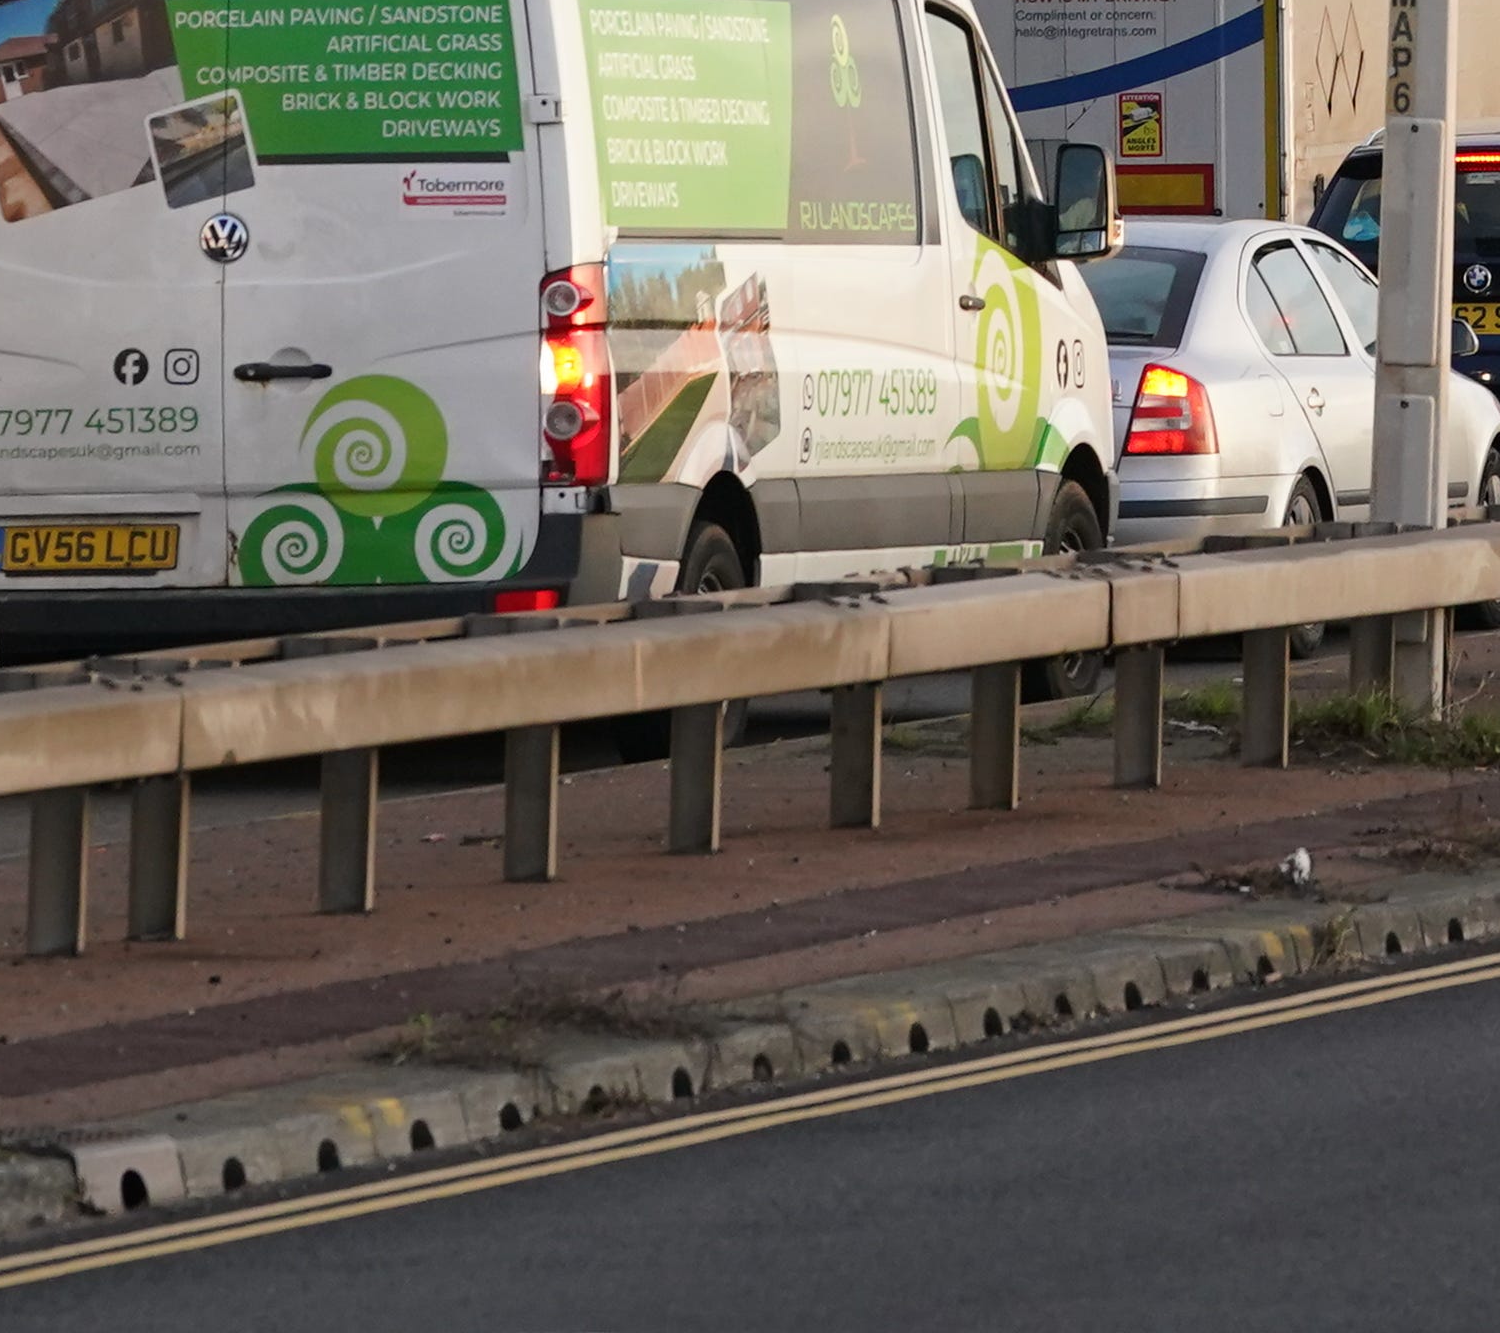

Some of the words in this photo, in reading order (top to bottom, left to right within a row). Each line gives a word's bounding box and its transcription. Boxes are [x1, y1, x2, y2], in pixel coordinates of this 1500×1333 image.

[175, 9, 284, 28] PORCELAIN
[290, 7, 364, 27] PAVING
[380, 5, 503, 24] SANDSTONE
[589, 9, 655, 37] PORCELAIN
[656, 10, 699, 41] PAVING
[704, 13, 771, 44] SANDSTONE
[1015, 10, 1087, 23] Compliment
[1090, 12, 1103, 21] or
[326, 34, 432, 54] ARTIFICIAL
[437, 33, 502, 52] GRASS
[1015, 25, 1157, 40] hello@integretrans.com
[196, 65, 309, 84] COMPOSITE
[315, 64, 328, 82] &
[332, 63, 408, 81] TIMBER
[412, 62, 502, 81] DECKING
[599, 52, 658, 80] ARTIFICIAL
[659, 54, 695, 81] GRASS
[282, 92, 341, 111] BRICK
[346, 92, 358, 110] &
[364, 91, 431, 110] BLOCK
[437, 90, 501, 109] WORK
[603, 94, 669, 122] COMPOSITE
[679, 97, 721, 124] TIMBER
[721, 98, 771, 125] DECKING
[382, 119, 501, 139] DRIVEWAYS
[606, 137, 643, 164] BRICK
[654, 139, 693, 165] BLOCK
[694, 139, 728, 165] WORK
[417, 178, 504, 192] Tobermore
[611, 181, 679, 208] DRIVEWAYS
[800, 202, 818, 229] RJ
[819, 201, 917, 230] LANDSCAPES
[817, 369, 873, 417] 07977
[879, 368, 936, 416] 451389
[84, 406, 199, 435] 451389
[10, 530, 94, 564] GV56
[104, 528, 171, 562] LCU
